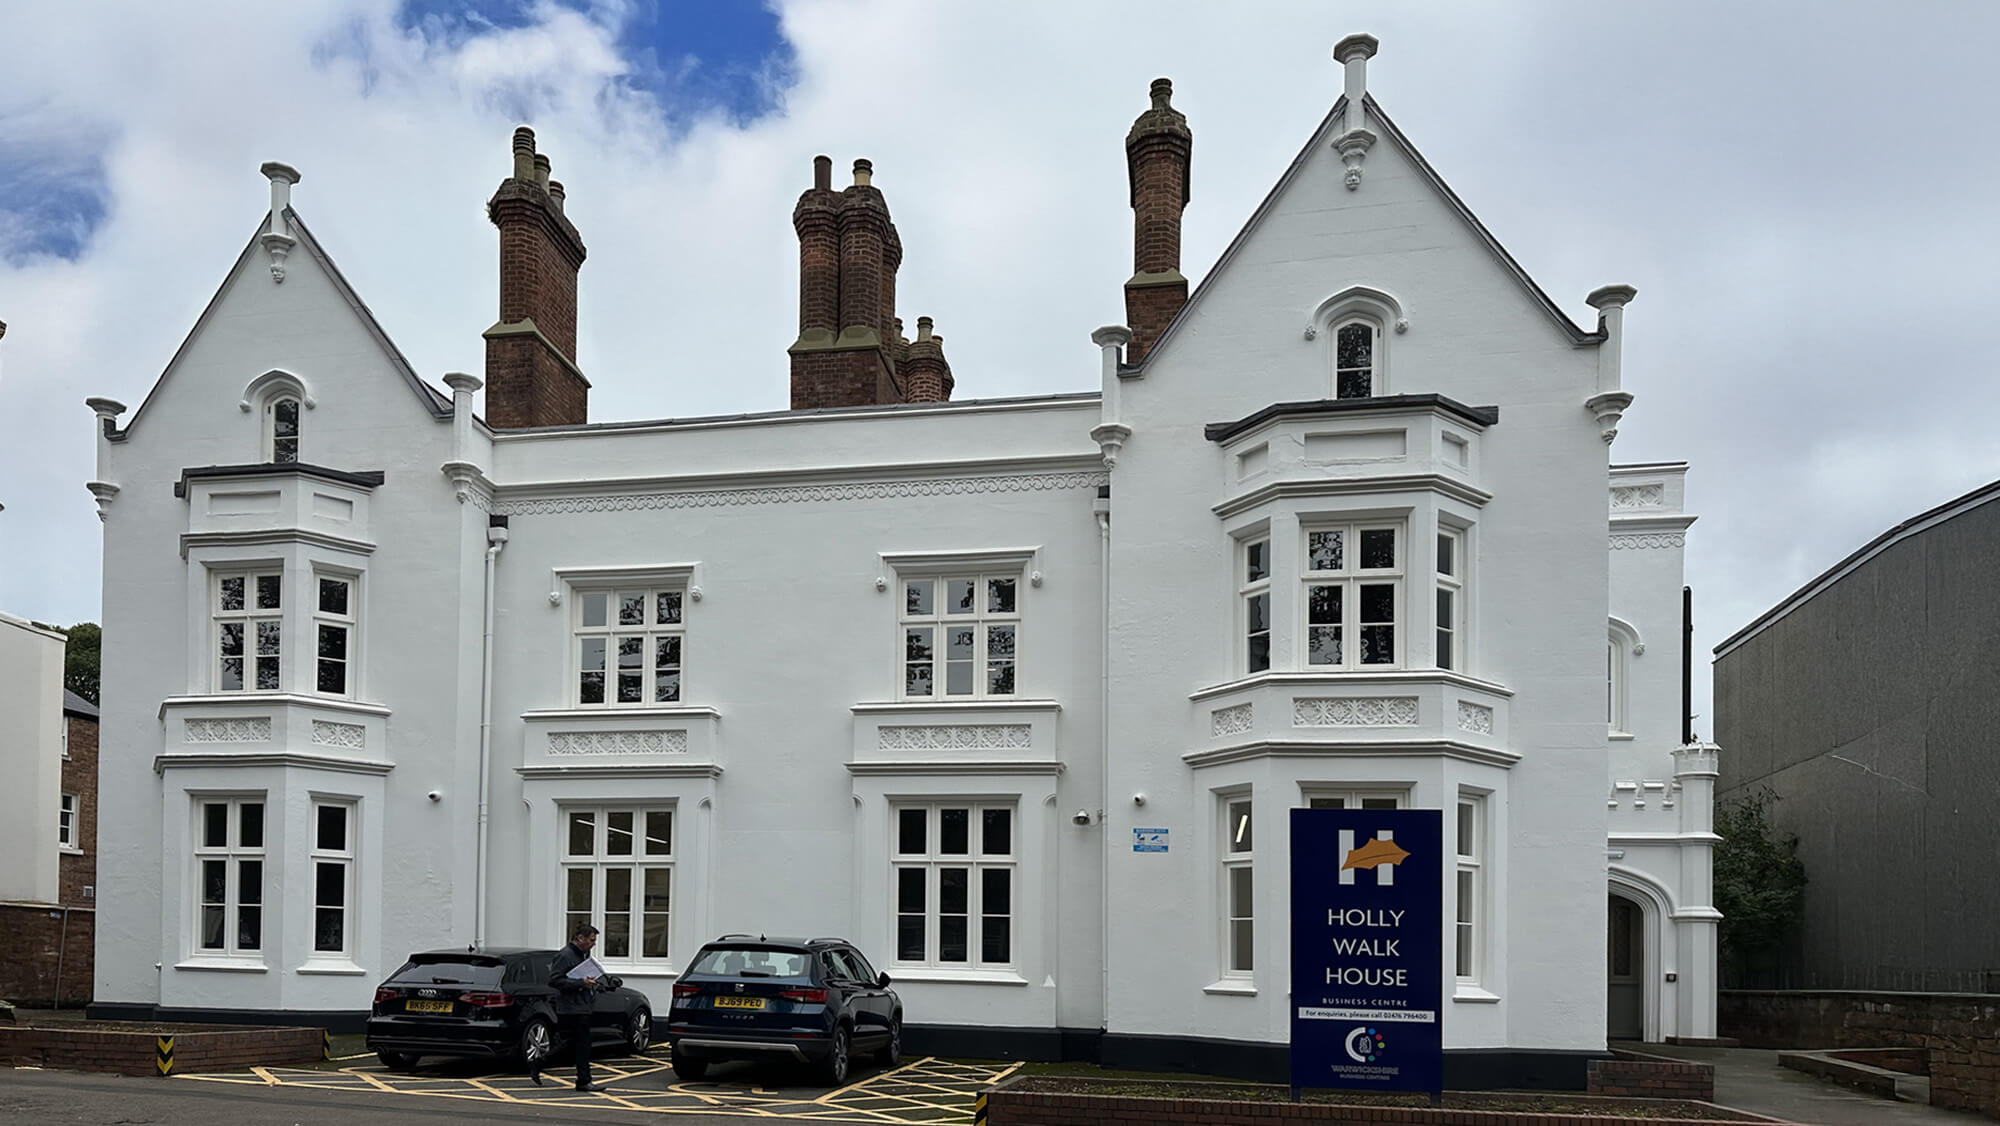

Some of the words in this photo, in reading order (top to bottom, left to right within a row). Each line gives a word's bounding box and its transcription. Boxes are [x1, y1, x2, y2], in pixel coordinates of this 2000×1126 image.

[1327, 908, 1405, 927] HOLLY
[1332, 938, 1400, 956] WALK
[1326, 967, 1408, 986] HOUSE
[1322, 997, 1367, 1006] BUSINESS
[1371, 999, 1408, 1007] CENTRE
[1349, 1011, 1370, 1019] please
[1331, 1065, 1399, 1075] WARWICKSHIRE
